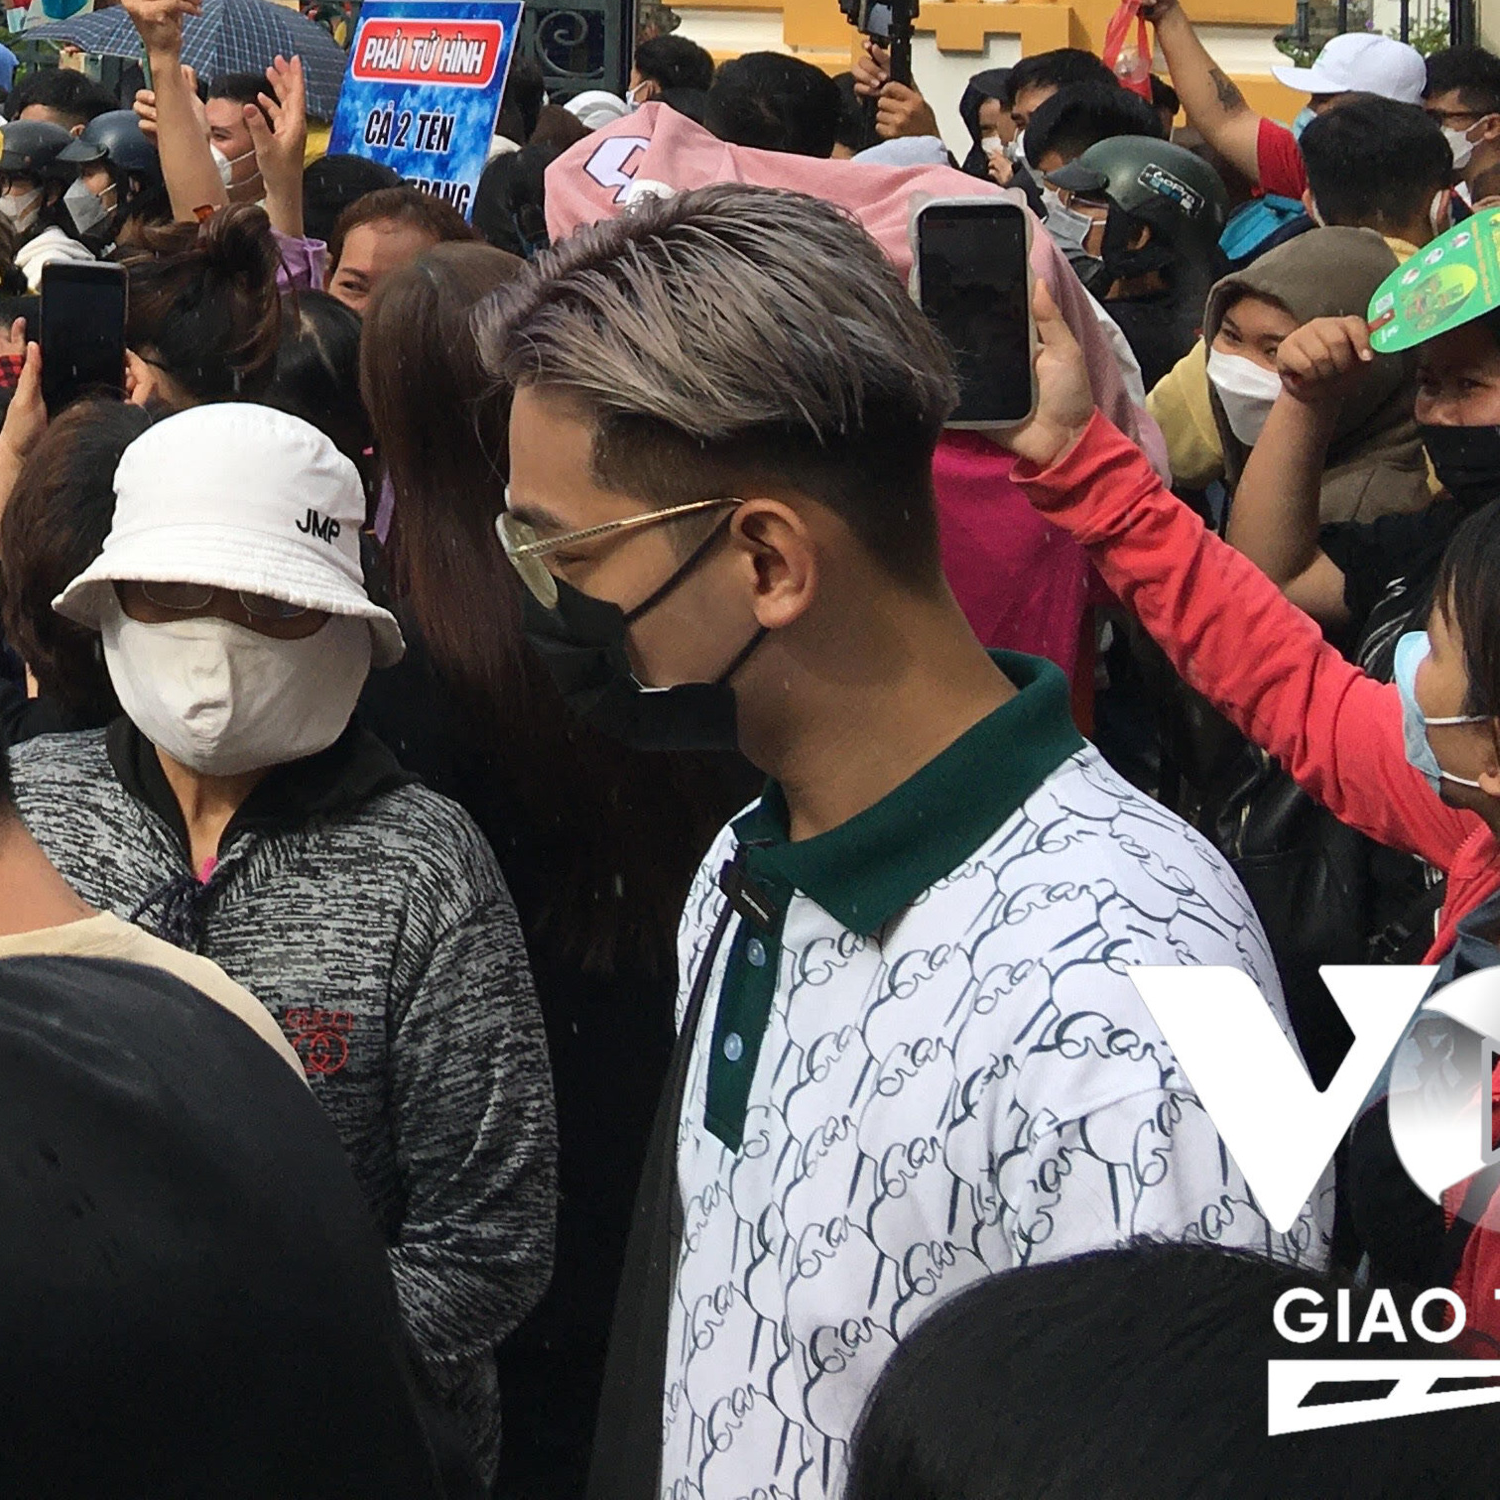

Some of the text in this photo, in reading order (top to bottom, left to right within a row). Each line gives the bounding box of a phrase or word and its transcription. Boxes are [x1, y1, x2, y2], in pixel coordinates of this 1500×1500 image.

[361, 27, 487, 75] PHẢI TỬ HÌNH
[364, 100, 456, 153] CẢ 2 TÊN
[402, 175, 471, 220] ANG
[295, 508, 341, 545] JMP
